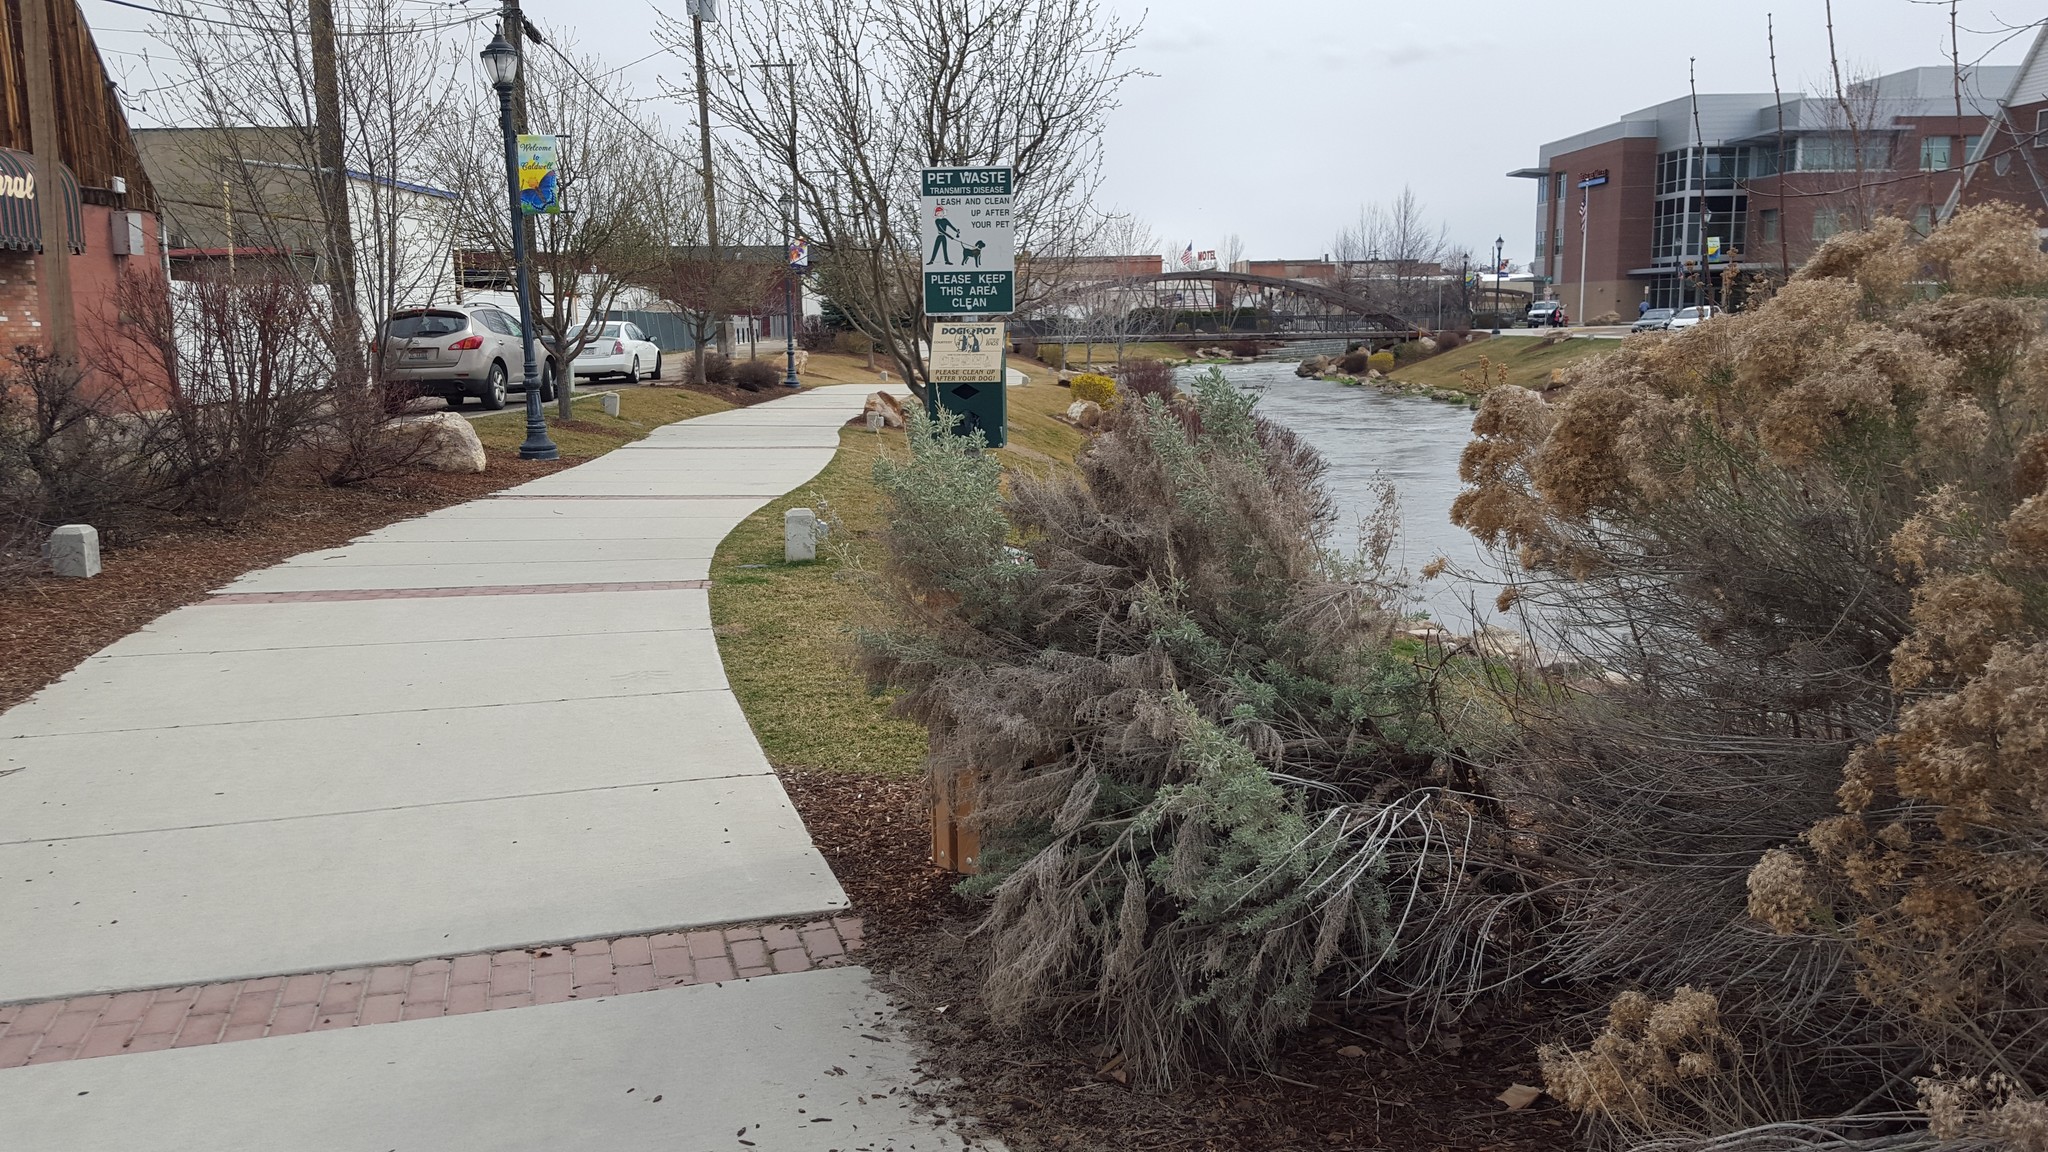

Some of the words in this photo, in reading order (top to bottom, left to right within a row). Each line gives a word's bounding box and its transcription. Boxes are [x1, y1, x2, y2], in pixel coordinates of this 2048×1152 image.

[519, 143, 552, 152] Welcome
[520, 161, 554, 171] Caldwell
[927, 172, 953, 184] PET
[959, 171, 1006, 184] WASTE
[929, 187, 971, 195] TRANSMITS
[973, 186, 1005, 194] DISEASE
[936, 198, 962, 206] LEASH
[965, 197, 981, 205] AND
[984, 197, 1010, 205] CLEAN
[970, 209, 982, 217] UP
[985, 208, 1010, 217] AFTER
[971, 220, 992, 229] YOUR
[995, 220, 1010, 228] PET
[1198, 250, 1216, 261] MOTEL
[931, 274, 972, 284] PLEASE
[978, 273, 1006, 284] KEEP
[939, 286, 964, 296] THIS
[969, 285, 998, 296] AREA
[951, 297, 987, 308] CLEAN
